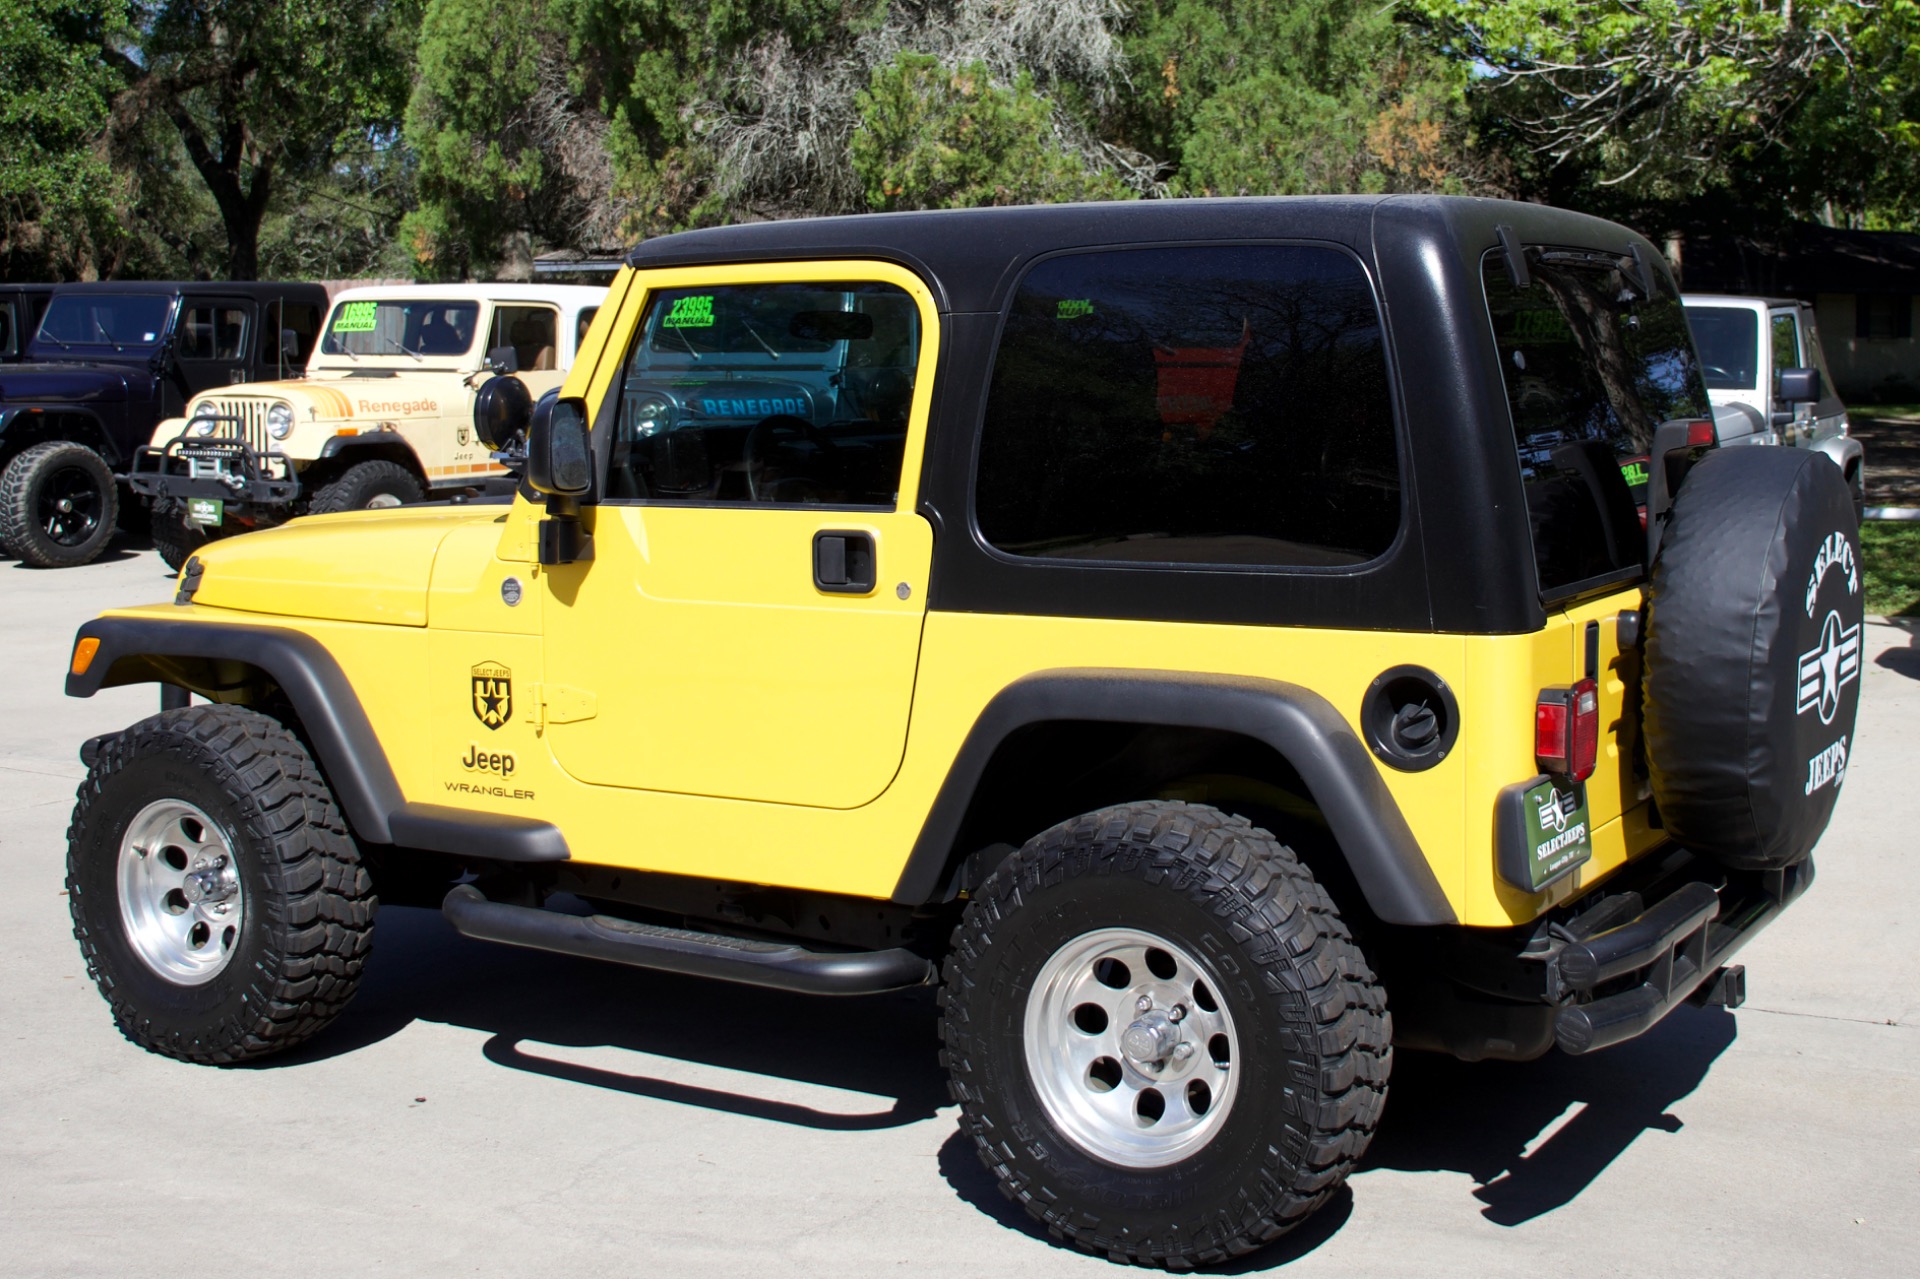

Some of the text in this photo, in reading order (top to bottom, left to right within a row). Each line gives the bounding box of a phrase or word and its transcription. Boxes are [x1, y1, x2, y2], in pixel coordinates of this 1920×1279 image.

[671, 296, 714, 317] 23995
[336, 321, 374, 330] MANUAL
[664, 316, 711, 326] MANUAL
[358, 398, 438, 415] Renegade
[703, 398, 806, 416] RENEGADE
[454, 451, 474, 461] Jeep
[1805, 531, 1858, 619] SELECT
[473, 668, 510, 678] SELECT JEEPS
[462, 745, 515, 777] Jeep
[1805, 734, 1846, 796] JEEPS
[444, 781, 536, 801] WRANGLER
[988, 934, 1023, 999] STT
